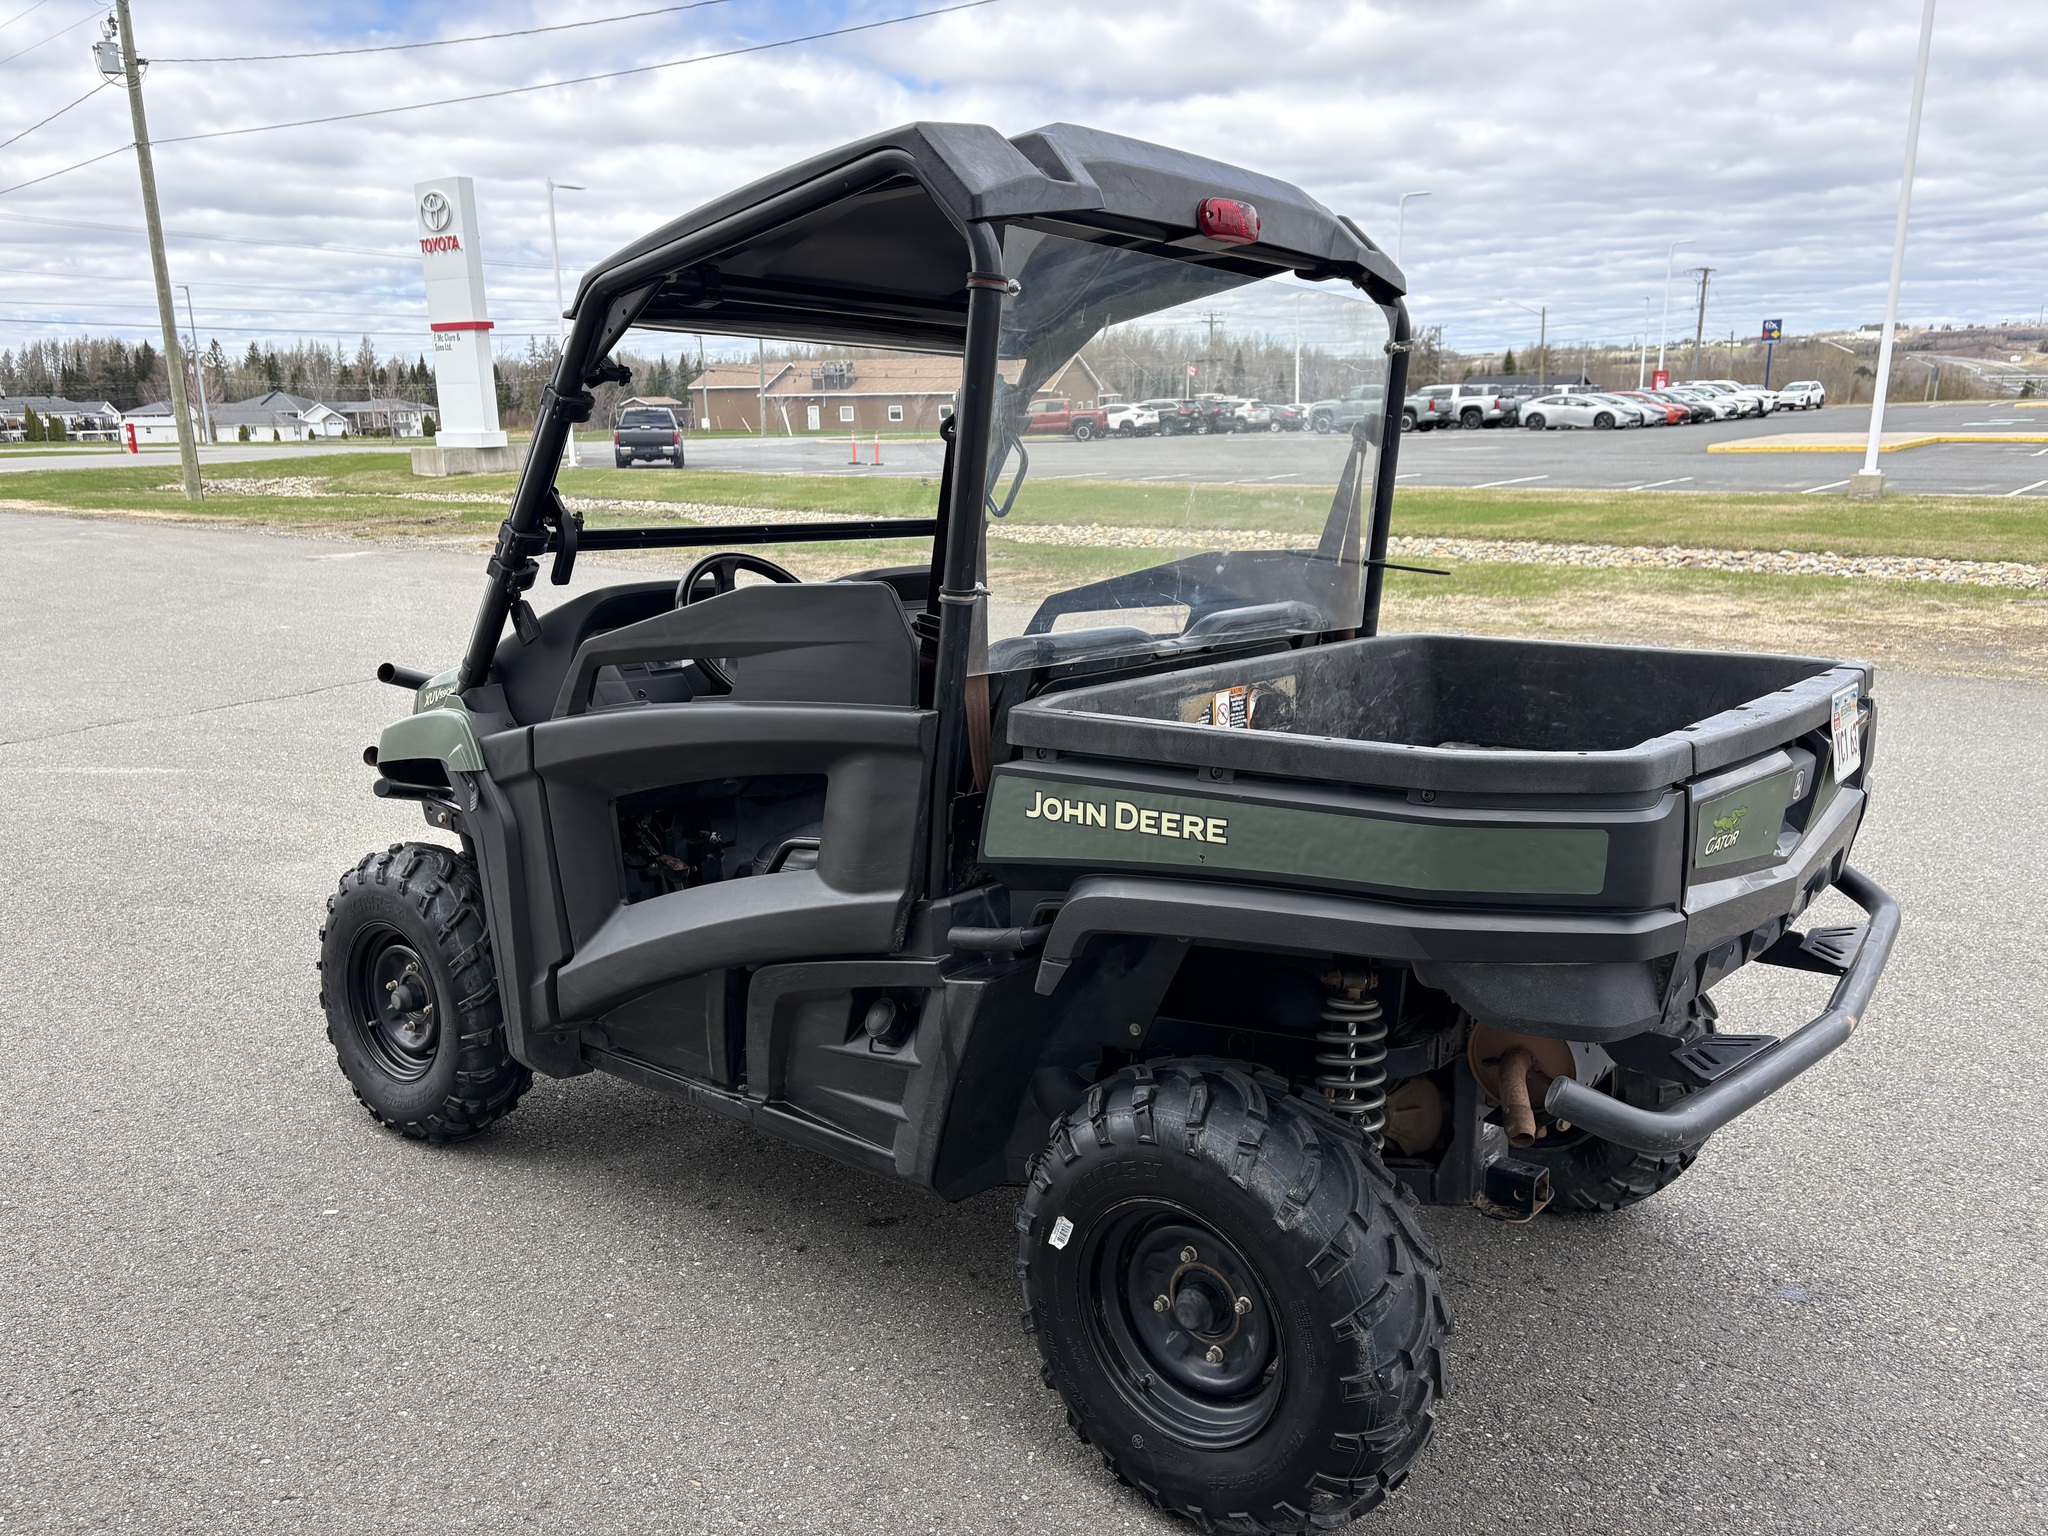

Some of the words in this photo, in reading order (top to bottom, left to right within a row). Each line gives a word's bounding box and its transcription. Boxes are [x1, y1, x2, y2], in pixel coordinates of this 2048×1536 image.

[419, 235, 461, 254] TOYOTA
[1025, 790, 1107, 828] JOHN
[1114, 799, 1229, 845] DEERE
[1705, 829, 1740, 857] GATOR
